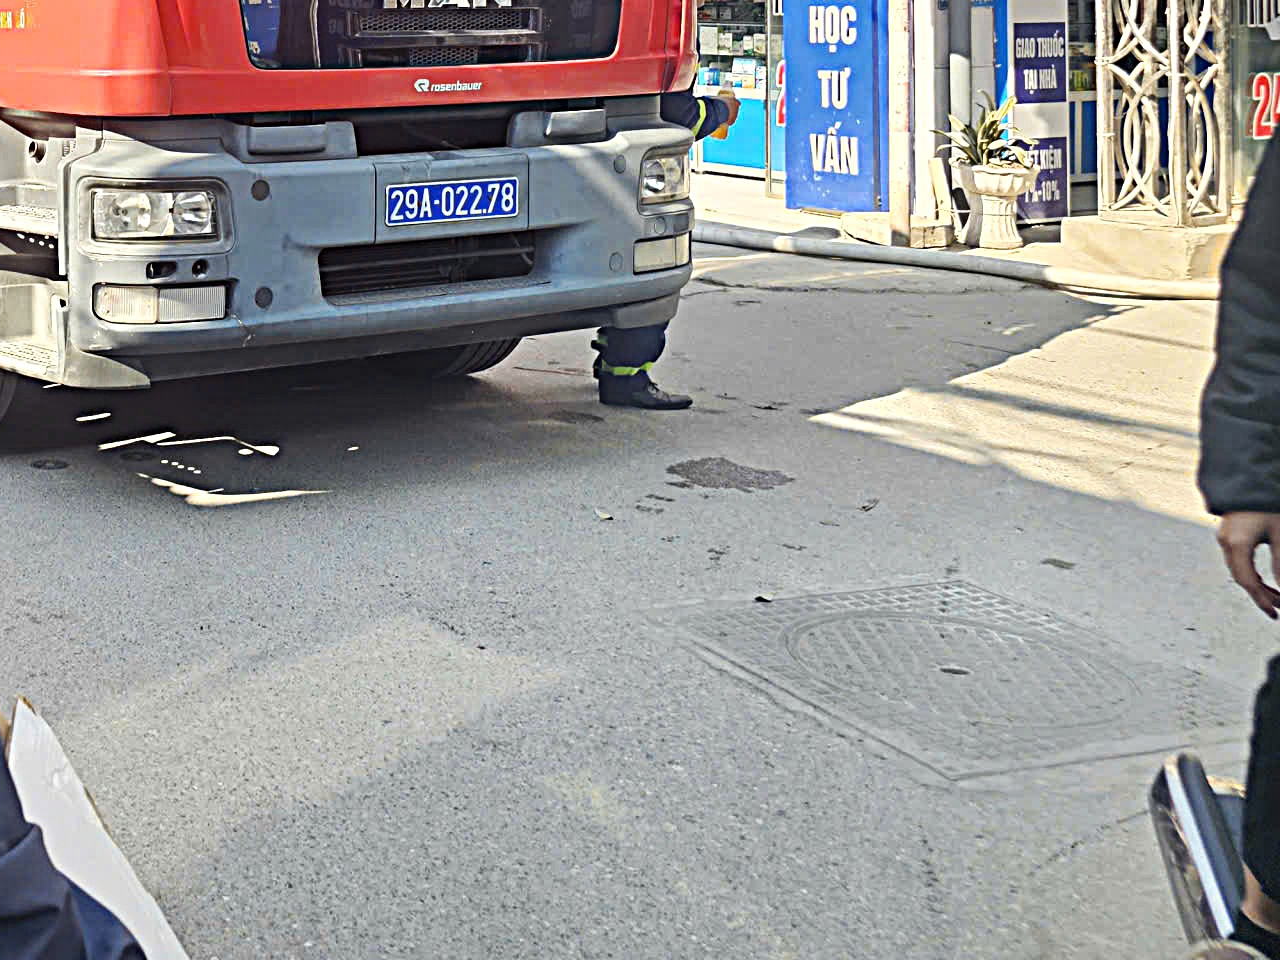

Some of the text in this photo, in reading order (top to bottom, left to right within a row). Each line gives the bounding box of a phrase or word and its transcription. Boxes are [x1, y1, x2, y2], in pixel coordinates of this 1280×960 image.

[808, 5, 857, 53] HỌC
[431, 80, 482, 92] rosenbauer
[817, 66, 851, 110] TƯ
[809, 121, 860, 176] VẤN
[390, 183, 514, 221] 29A-022.78
